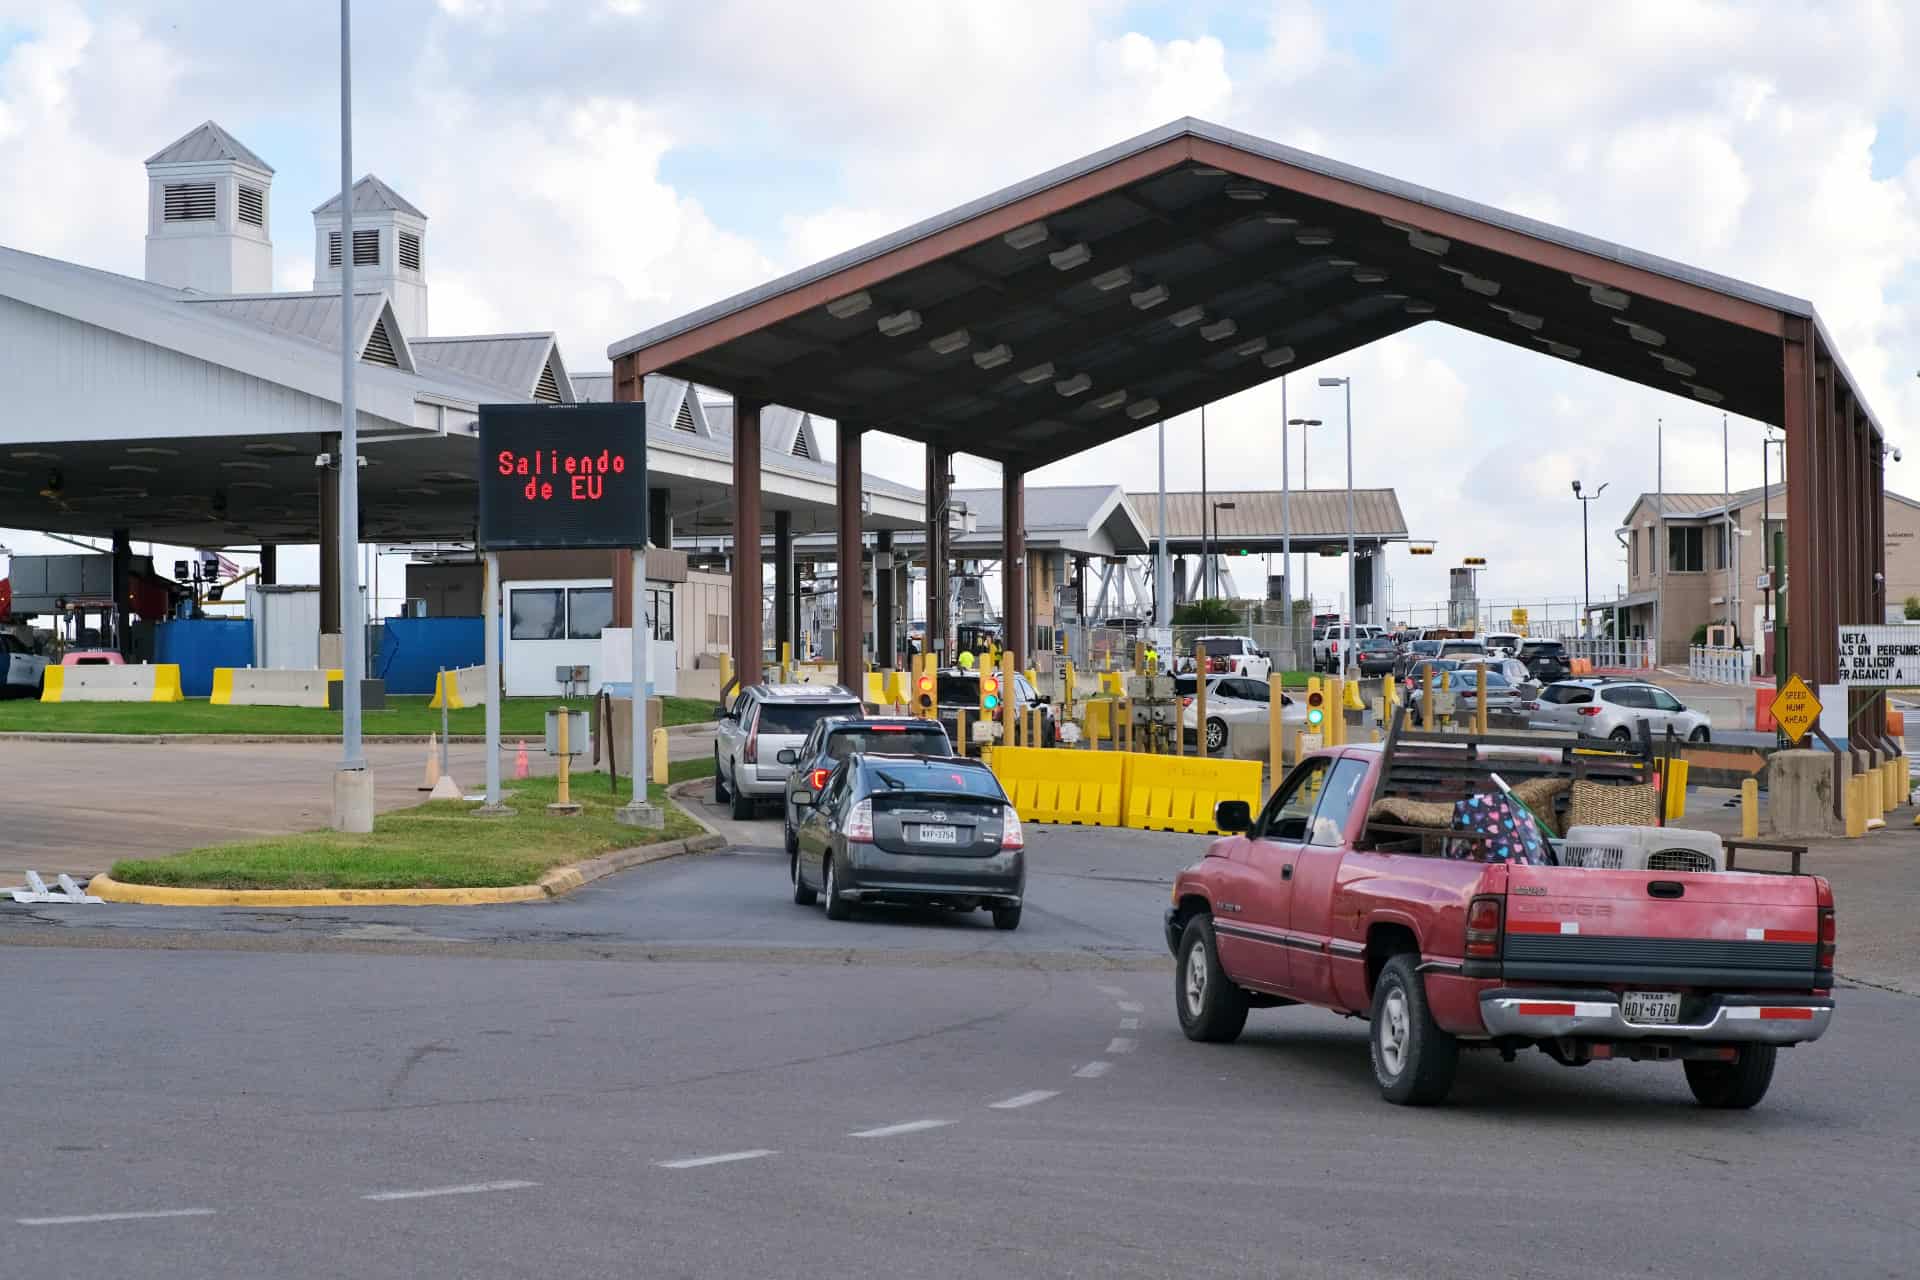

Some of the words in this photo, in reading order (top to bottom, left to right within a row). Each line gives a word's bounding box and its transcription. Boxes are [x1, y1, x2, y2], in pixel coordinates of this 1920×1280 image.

[498, 449, 625, 475] Saliendo
[525, 476, 553, 500] de
[571, 475, 602, 500] EU
[1842, 633, 1867, 644] UETA
[1857, 645, 1871, 656] ON
[1853, 657, 1865, 668] EN
[1867, 657, 1895, 668] LICOR
[1785, 691, 1807, 699] SPEED
[1786, 703, 1806, 712] HUMP
[1784, 715, 1808, 724] AHEAD
